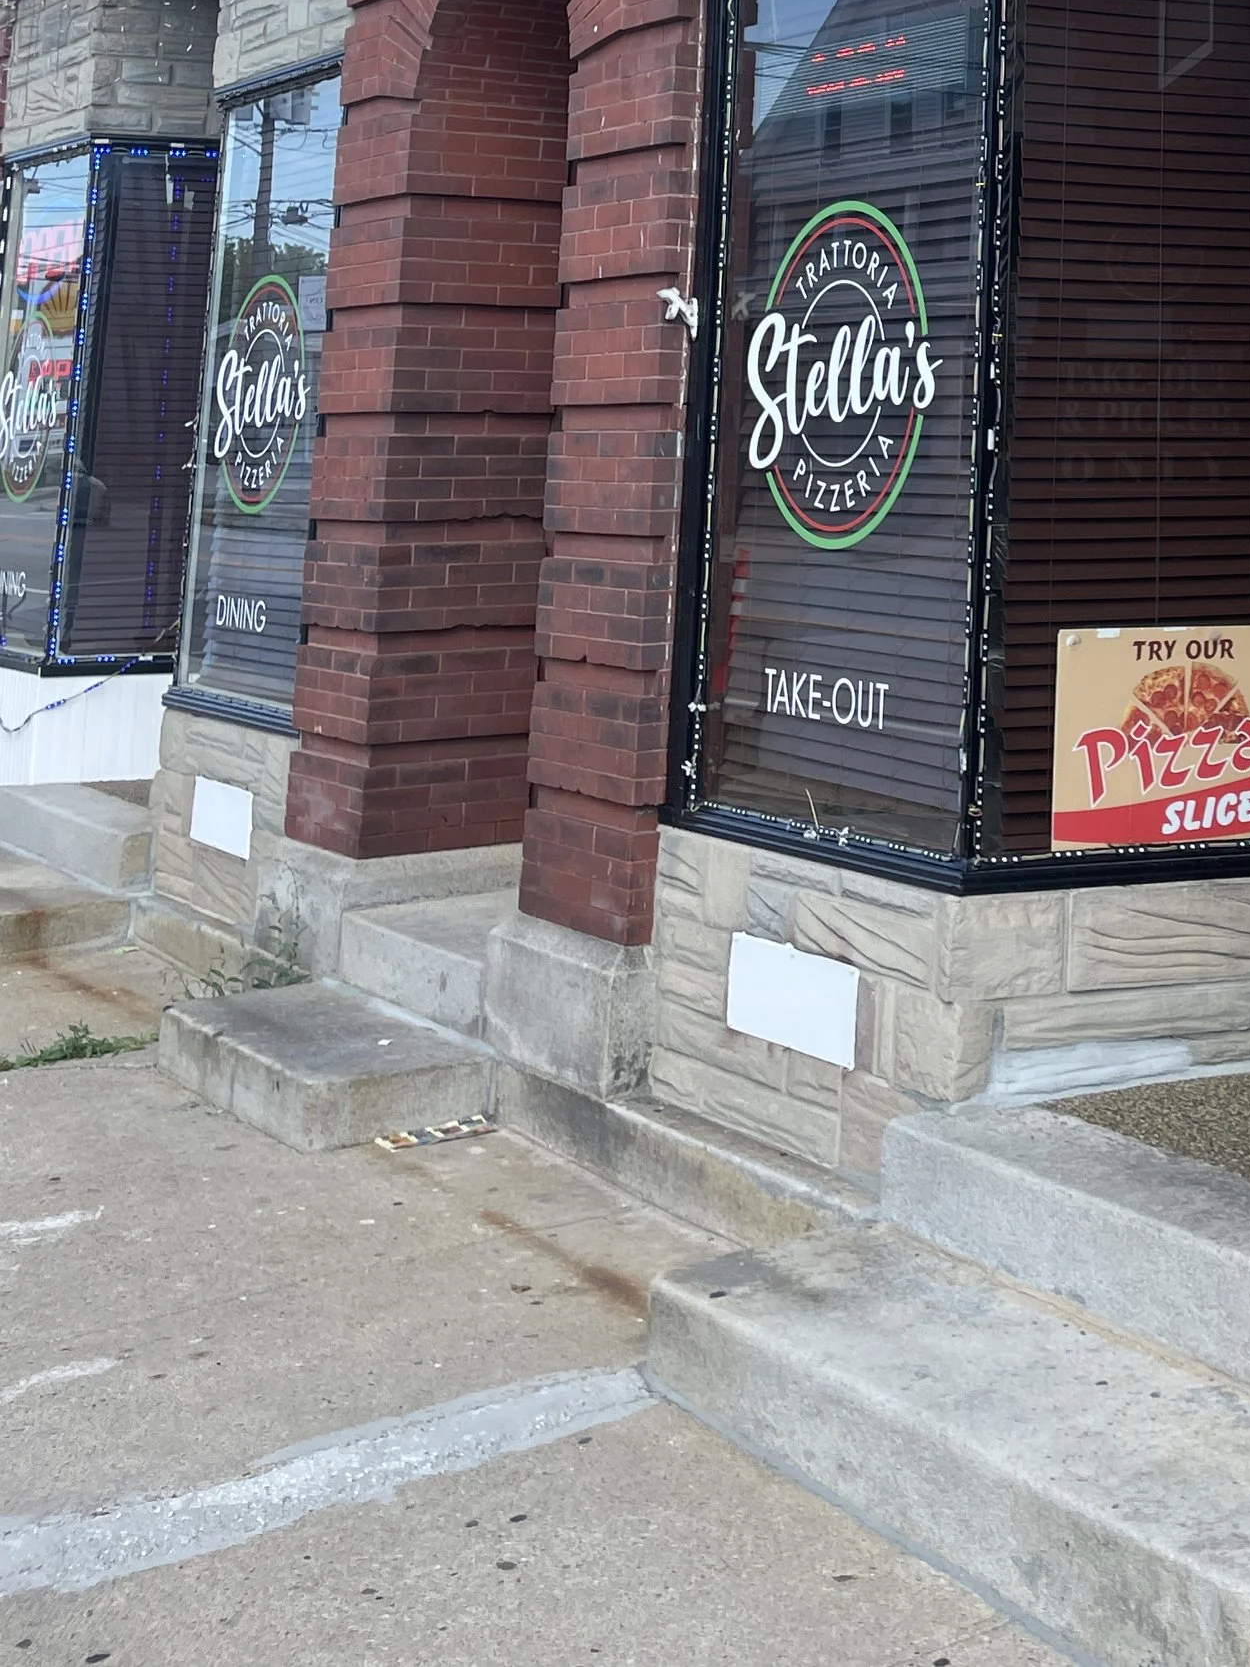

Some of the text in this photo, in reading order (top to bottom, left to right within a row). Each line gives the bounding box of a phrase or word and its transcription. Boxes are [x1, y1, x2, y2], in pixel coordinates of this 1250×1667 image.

[796, 240, 898, 309] TRATTORIA
[244, 301, 293, 352] TRATTORIA
[0, 371, 58, 459] Stella's
[214, 349, 310, 458] Stella's
[747, 312, 943, 469] Stella's
[235, 436, 284, 489] PIZZERIA
[793, 435, 893, 512] PIZZERIA
[216, 595, 266, 632] DINING
[1133, 639, 1234, 661] TRY OUR
[765, 668, 889, 729] TAKE-OUT
